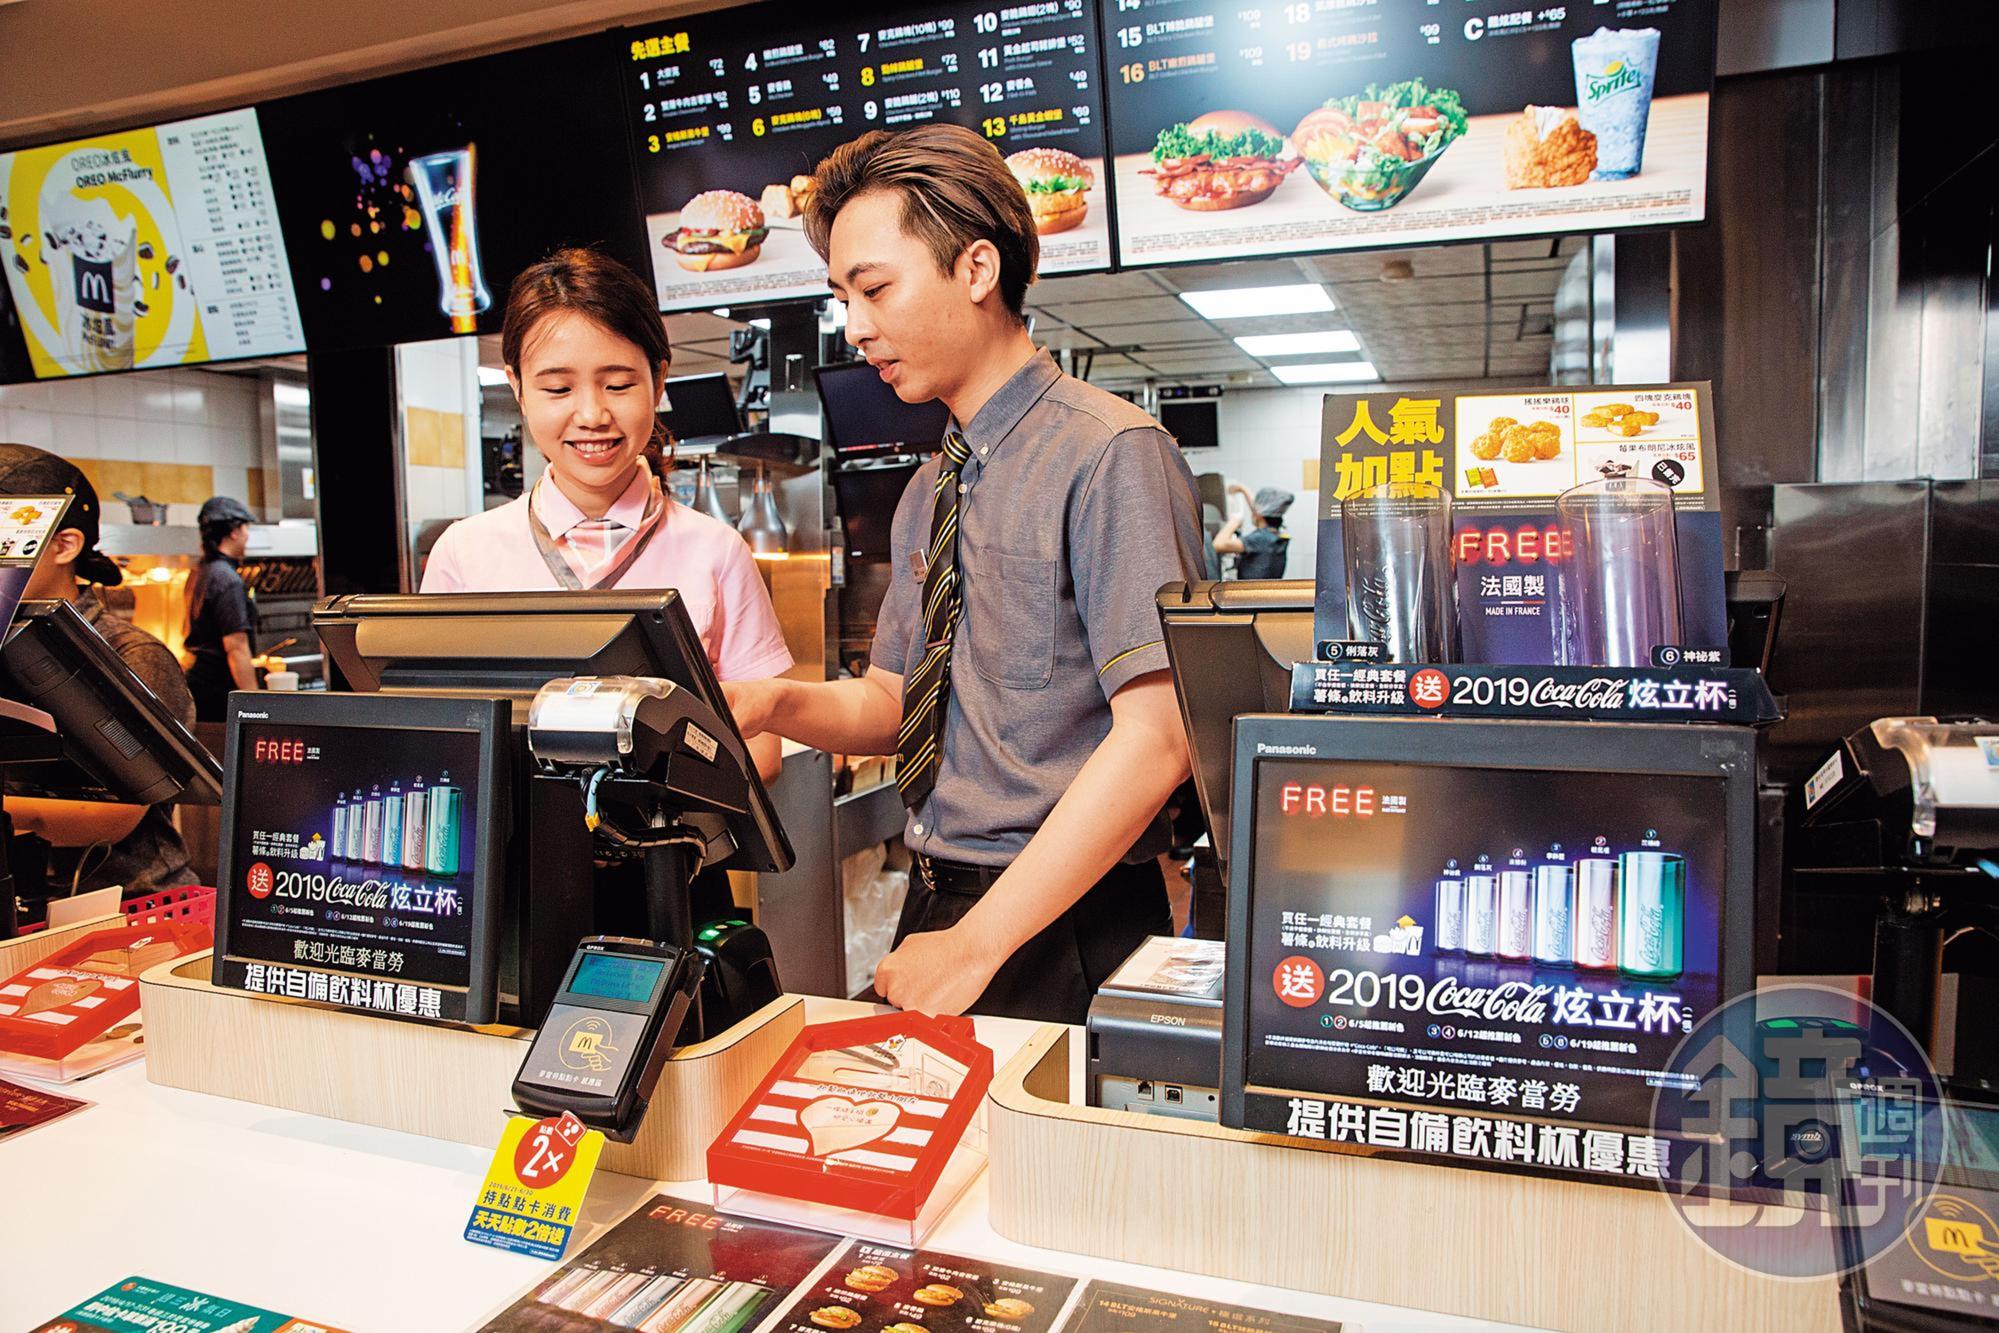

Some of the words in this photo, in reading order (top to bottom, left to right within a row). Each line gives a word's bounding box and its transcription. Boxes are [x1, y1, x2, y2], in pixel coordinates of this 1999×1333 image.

[973, 12, 998, 34] 10
[1284, 3, 1311, 24] 18
[1117, 26, 1142, 48] 15
[1464, 18, 1484, 40] C
[857, 33, 870, 53] 7
[1286, 41, 1311, 61] 19
[744, 52, 758, 71] 4
[978, 47, 999, 68] 11
[640, 72, 650, 90] 1
[861, 67, 875, 87] 8
[942, 53, 958, 66] $72
[1120, 63, 1145, 84] 16
[748, 85, 761, 104] 5
[980, 82, 1004, 103] 12
[1069, 70, 1087, 82] $49
[1588, 67, 1638, 100] Sprite
[644, 103, 656, 122] 2
[864, 101, 877, 120] 9
[752, 118, 765, 137] 6
[982, 117, 1006, 138] 13
[648, 135, 660, 153] 3
[76, 173, 106, 189] OREO
[107, 168, 153, 183] McFlurry
[1671, 401, 1693, 411] $40
[1334, 397, 1446, 447] 人氣
[1674, 451, 1696, 461] $65
[1332, 449, 1444, 502] 加點
[1459, 530, 1561, 562] FREE
[1480, 575, 1546, 597] 法國製
[1485, 606, 1504, 615] MADE
[1506, 607, 1513, 615] IN
[1514, 607, 1541, 616] FRANCE
[1314, 668, 1407, 683] 買任一經典套餐
[1415, 675, 1442, 702] 送
[1453, 676, 1530, 706] 2019
[1530, 676, 1630, 709] Coca-Cola
[1628, 678, 1729, 711] 炫立杯
[238, 710, 269, 720] Panasonic
[255, 740, 305, 762] FREE
[1257, 742, 1317, 756] Panasonic
[1282, 785, 1375, 817] FREE
[251, 869, 268, 893] 送
[275, 871, 325, 901] 2019
[325, 876, 391, 910] Coca-Cola
[391, 882, 458, 916] 炫立杯
[294, 939, 405, 973] 歡迎光臨麥當勞
[244, 963, 442, 1019] 提供自備飲料杯優惠
[1281, 964, 1315, 999] 送
[1328, 968, 1426, 1012] 2019
[1426, 976, 1554, 1024] Coca-Cola
[1552, 985, 1683, 1034] 炫立杯
[1150, 1014, 1186, 1026] EPSON
[1366, 1063, 1582, 1114] 歡迎光臨麥當勞
[1287, 1098, 1672, 1179] 提供自備飲料杯優惠
[482, 1189, 572, 1223] 持點點卡消費
[649, 1204, 724, 1230] FREE
[472, 1210, 566, 1246] 天天點數2倍送
